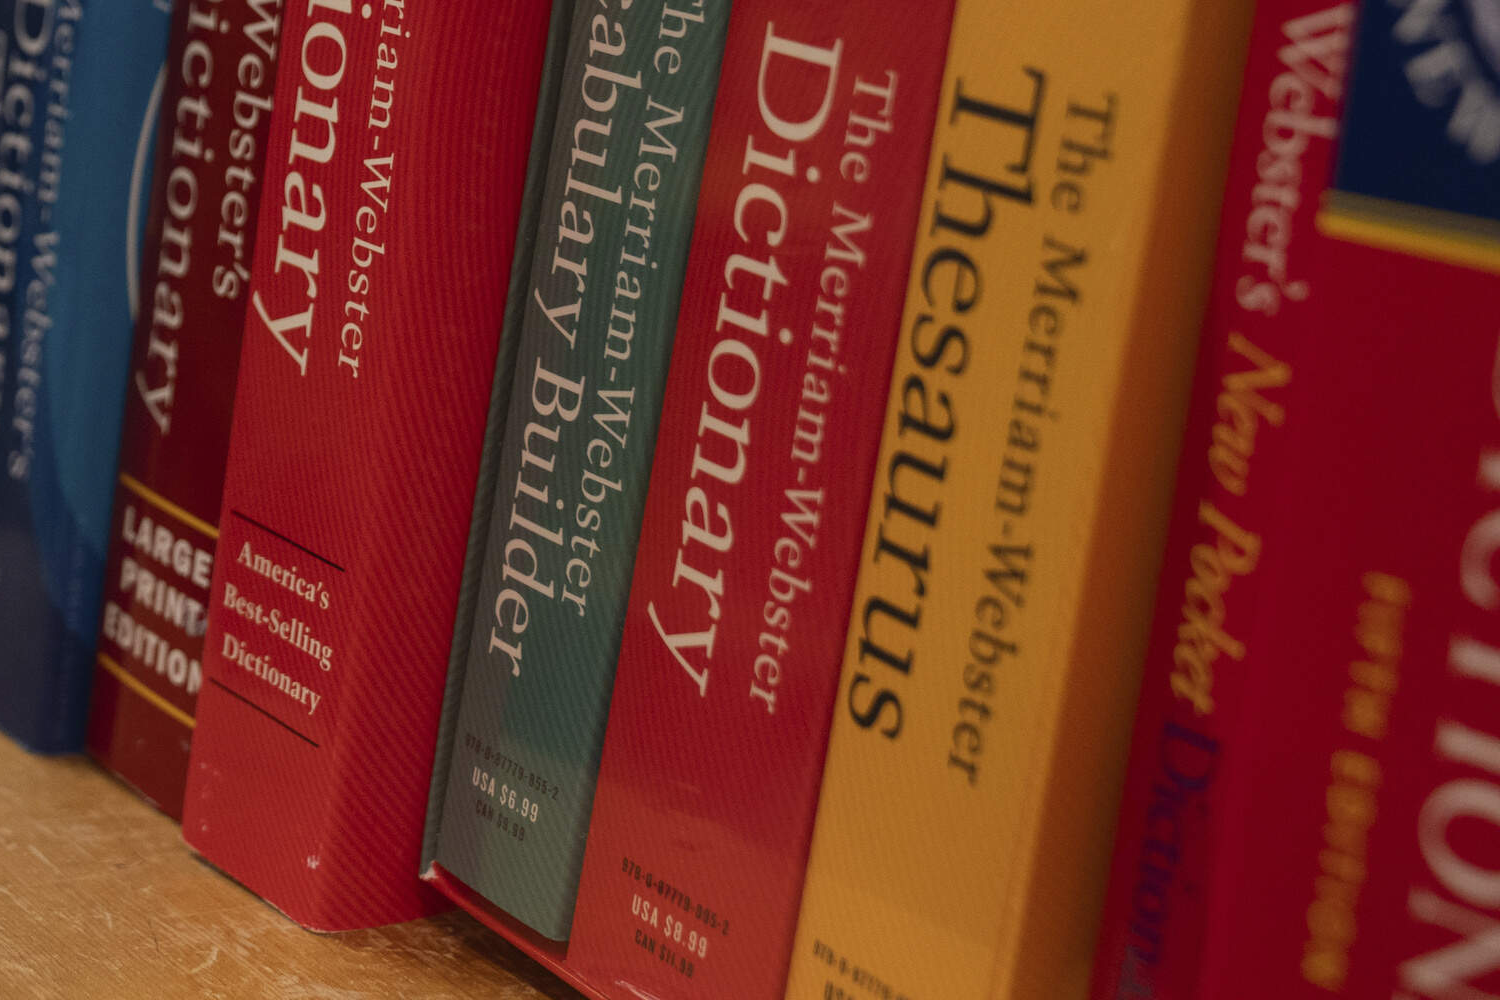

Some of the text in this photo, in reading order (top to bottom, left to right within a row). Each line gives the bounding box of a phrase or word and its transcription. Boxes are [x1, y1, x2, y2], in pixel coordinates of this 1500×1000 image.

[1235, 2, 1359, 316] Webster's
[561, 95, 686, 618] Merriam-Webster
[647, 20, 844, 698] Dictionary
[749, 68, 899, 716] The Merriam-Webster
[846, 66, 1046, 743] Thesaurus
[947, 91, 1121, 788] The Merriam-Webster
[121, 505, 215, 589] LARGE
[488, 357, 586, 678] Builder
[237, 540, 330, 611] America's
[102, 602, 203, 695] EDITION
[223, 581, 334, 673] Best-Selling
[221, 633, 322, 716] Dictionary
[471, 766, 540, 825] USA $6.99
[630, 893, 708, 960] USA $8.99
[634, 929, 659, 957] CAN
